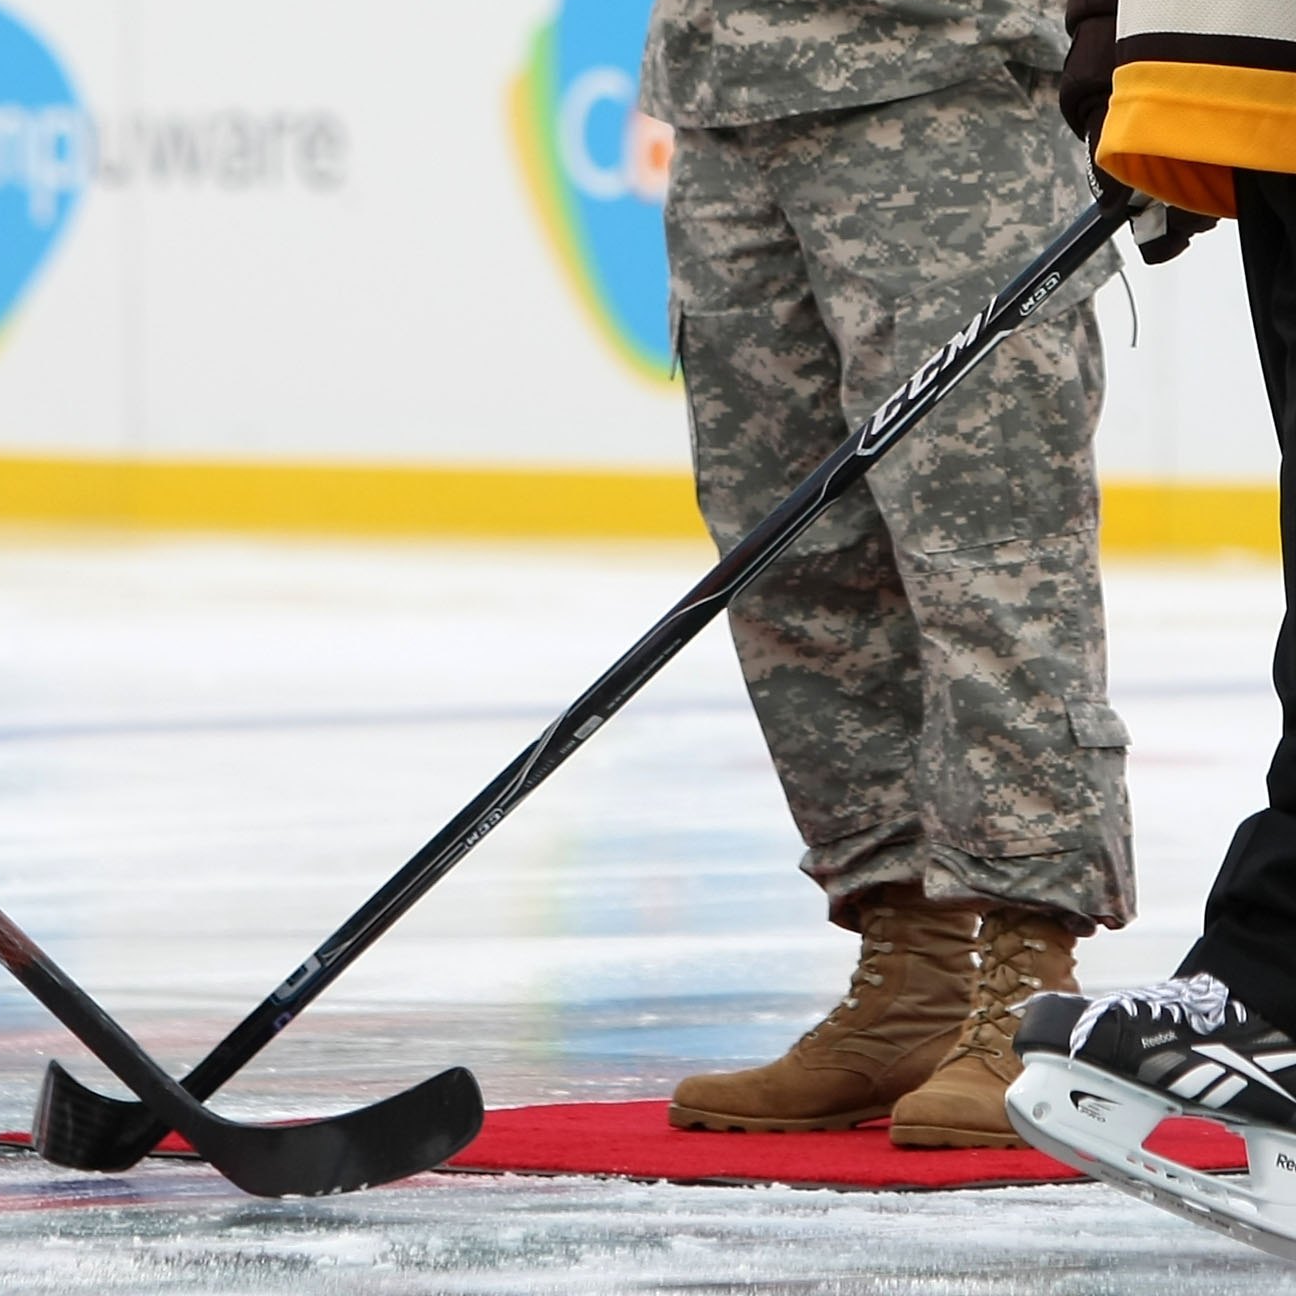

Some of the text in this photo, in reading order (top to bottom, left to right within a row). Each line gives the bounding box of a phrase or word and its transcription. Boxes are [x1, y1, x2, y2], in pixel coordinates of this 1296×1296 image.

[1021, 277, 1060, 312] CCM
[870, 311, 986, 438] CCM
[1141, 1029, 1178, 1049] Reebok
